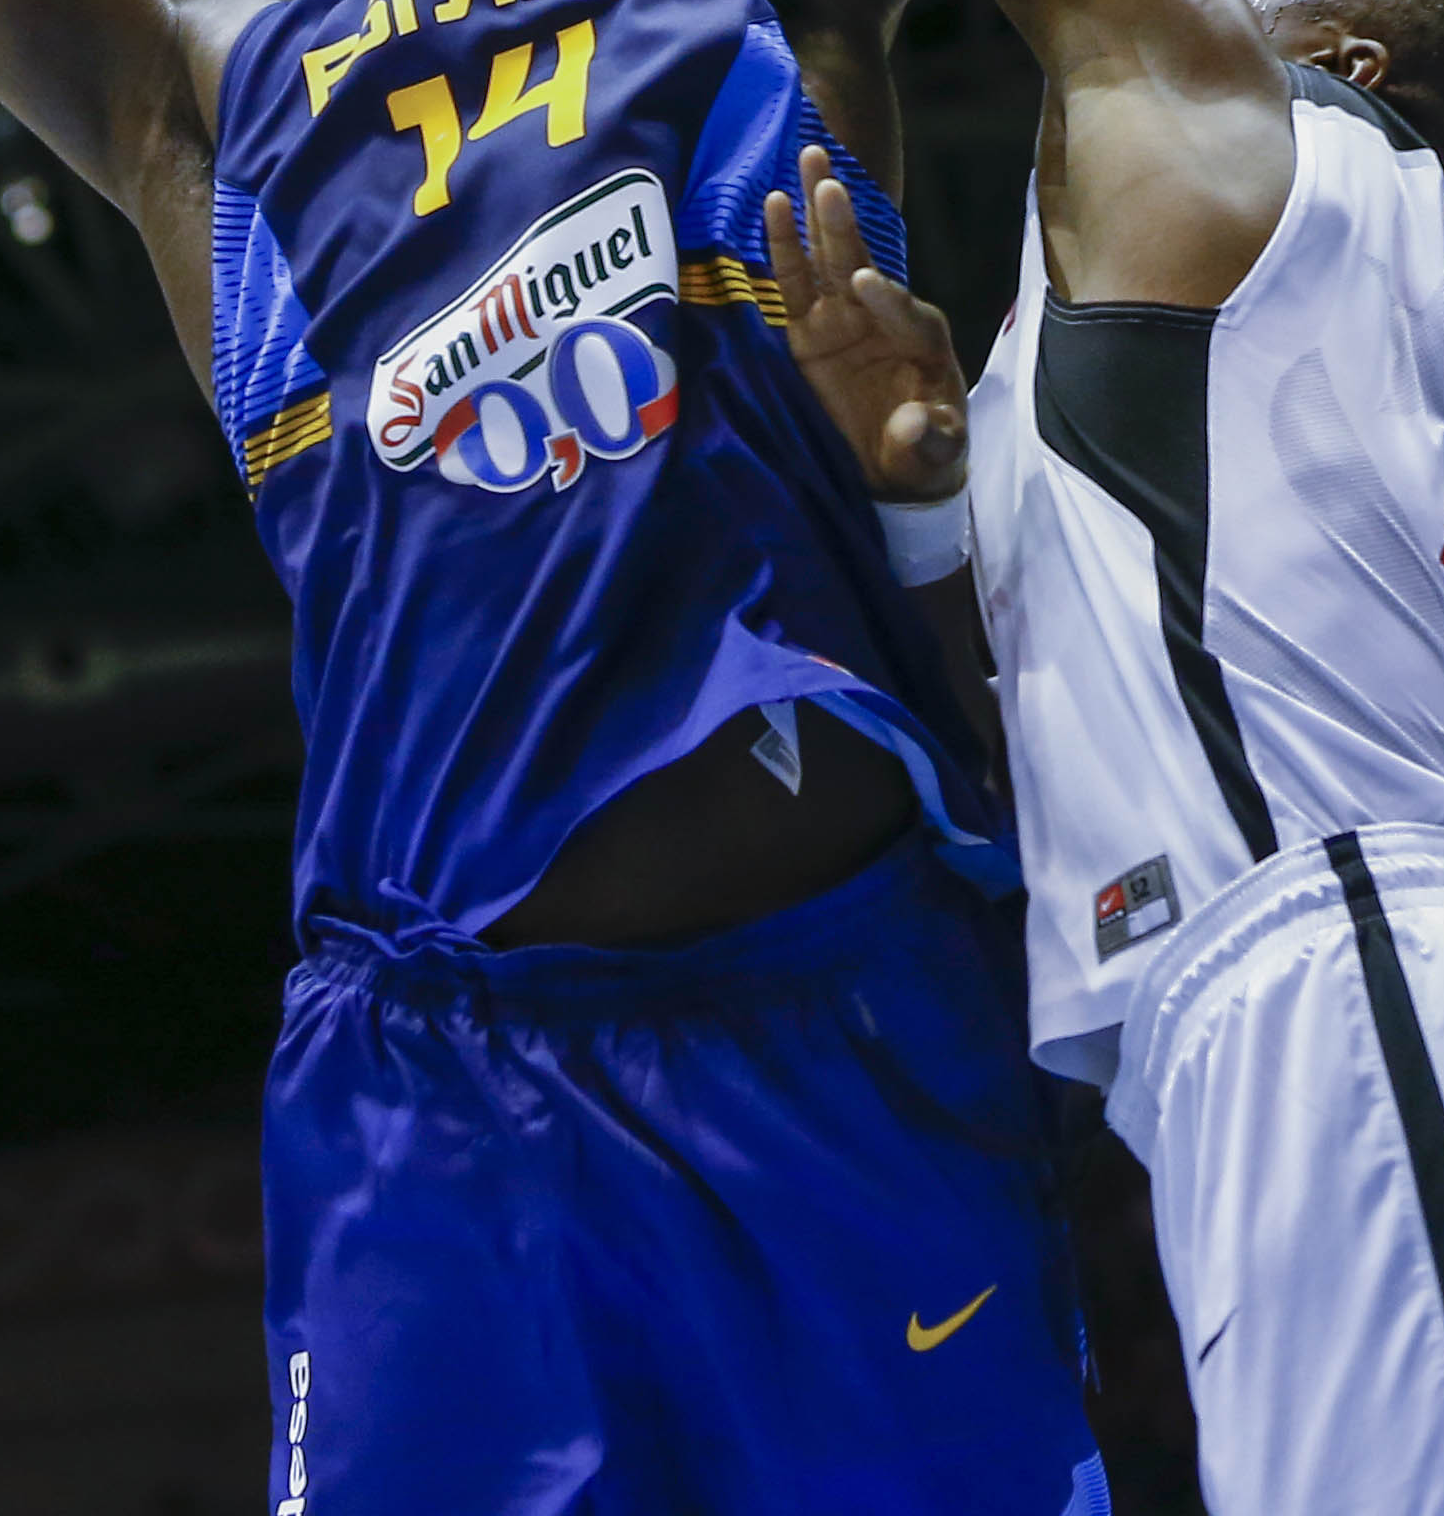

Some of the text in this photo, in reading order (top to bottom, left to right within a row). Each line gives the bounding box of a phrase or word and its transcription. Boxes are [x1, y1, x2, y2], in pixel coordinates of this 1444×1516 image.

[385, 18, 596, 218] 14
[380, 204, 652, 448] San Miguel
[453, 319, 662, 491] 0,0
